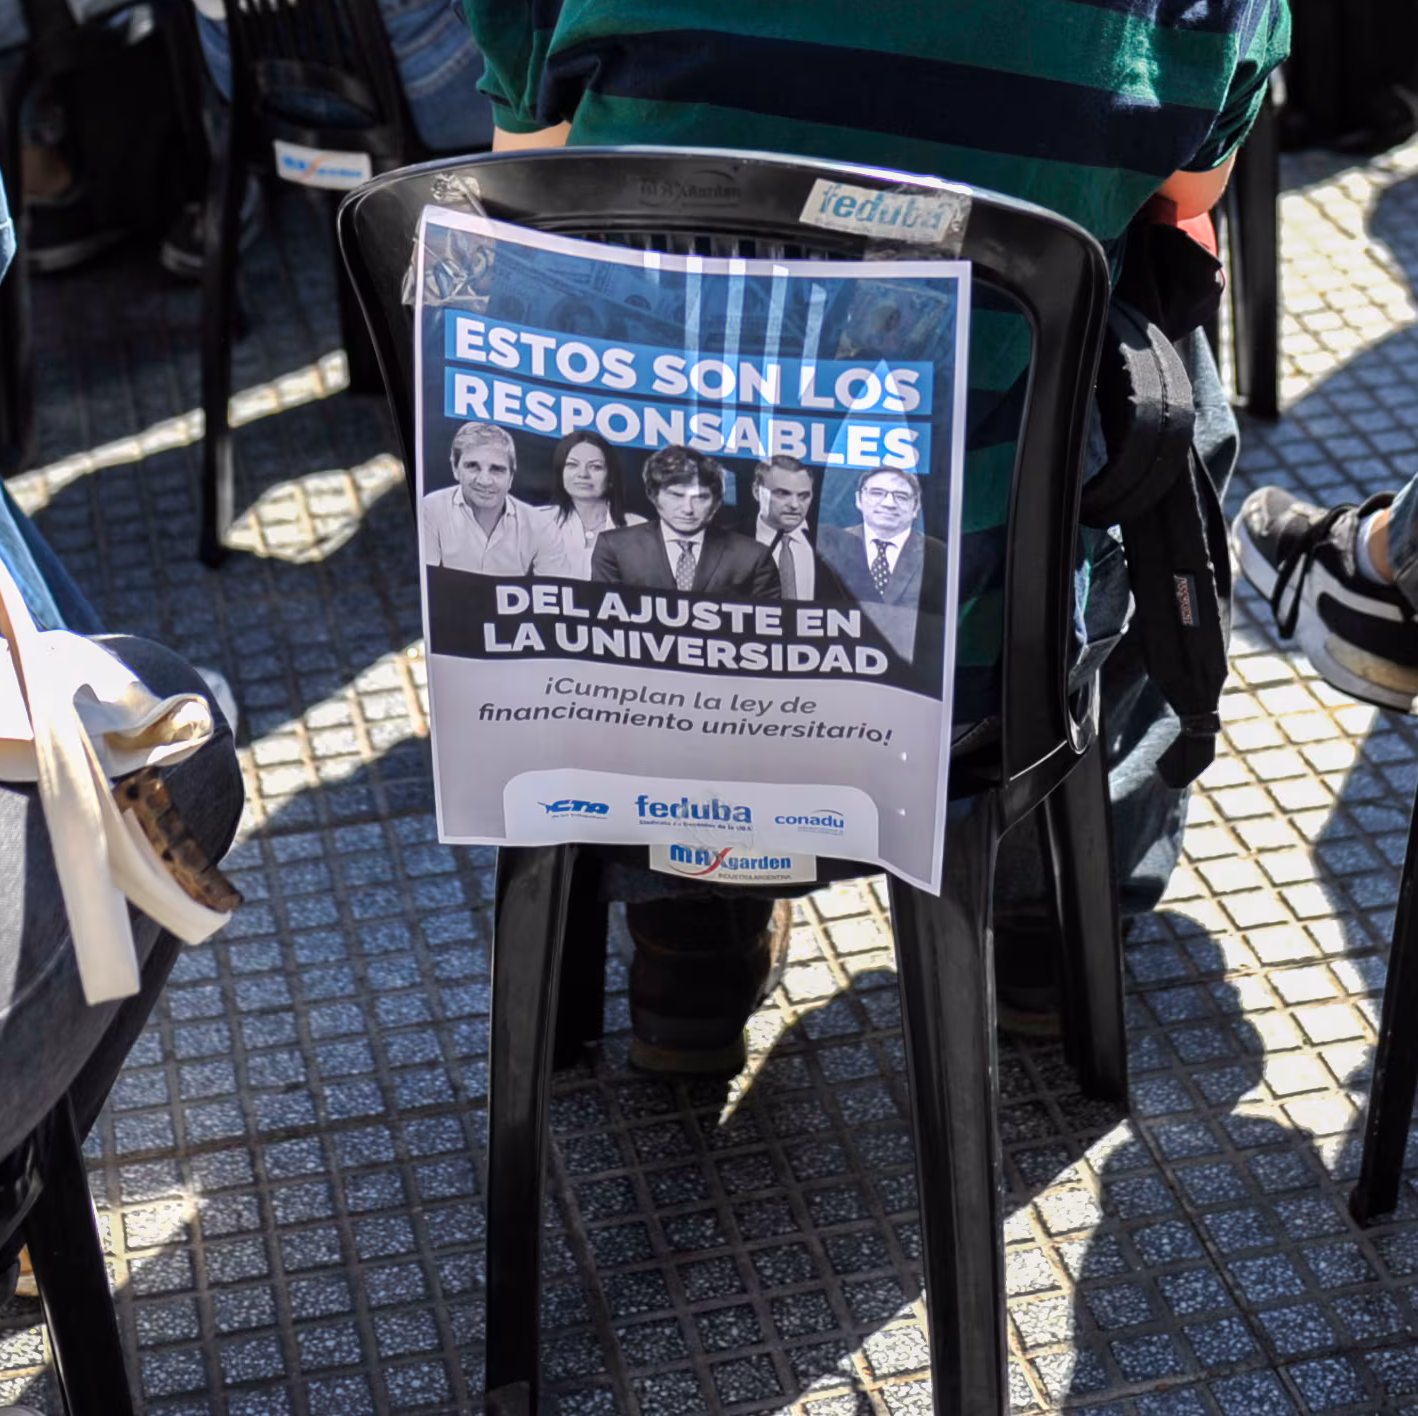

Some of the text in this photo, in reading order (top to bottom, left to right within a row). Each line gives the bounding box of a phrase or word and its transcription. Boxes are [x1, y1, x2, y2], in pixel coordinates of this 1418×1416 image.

[818, 182, 947, 231] feduba
[455, 316, 921, 413] ESTOS SON LOS
[453, 373, 921, 469] RESPONSABLES
[495, 584, 862, 639] DEL AJUSTE EN
[483, 622, 889, 676] LA UNIVERSIDAD
[544, 677, 818, 718] ¡Cumplan la ley de
[478, 702, 893, 747] financiamiento universitario!
[634, 794, 752, 824] feduba
[774, 814, 845, 829] conadu
